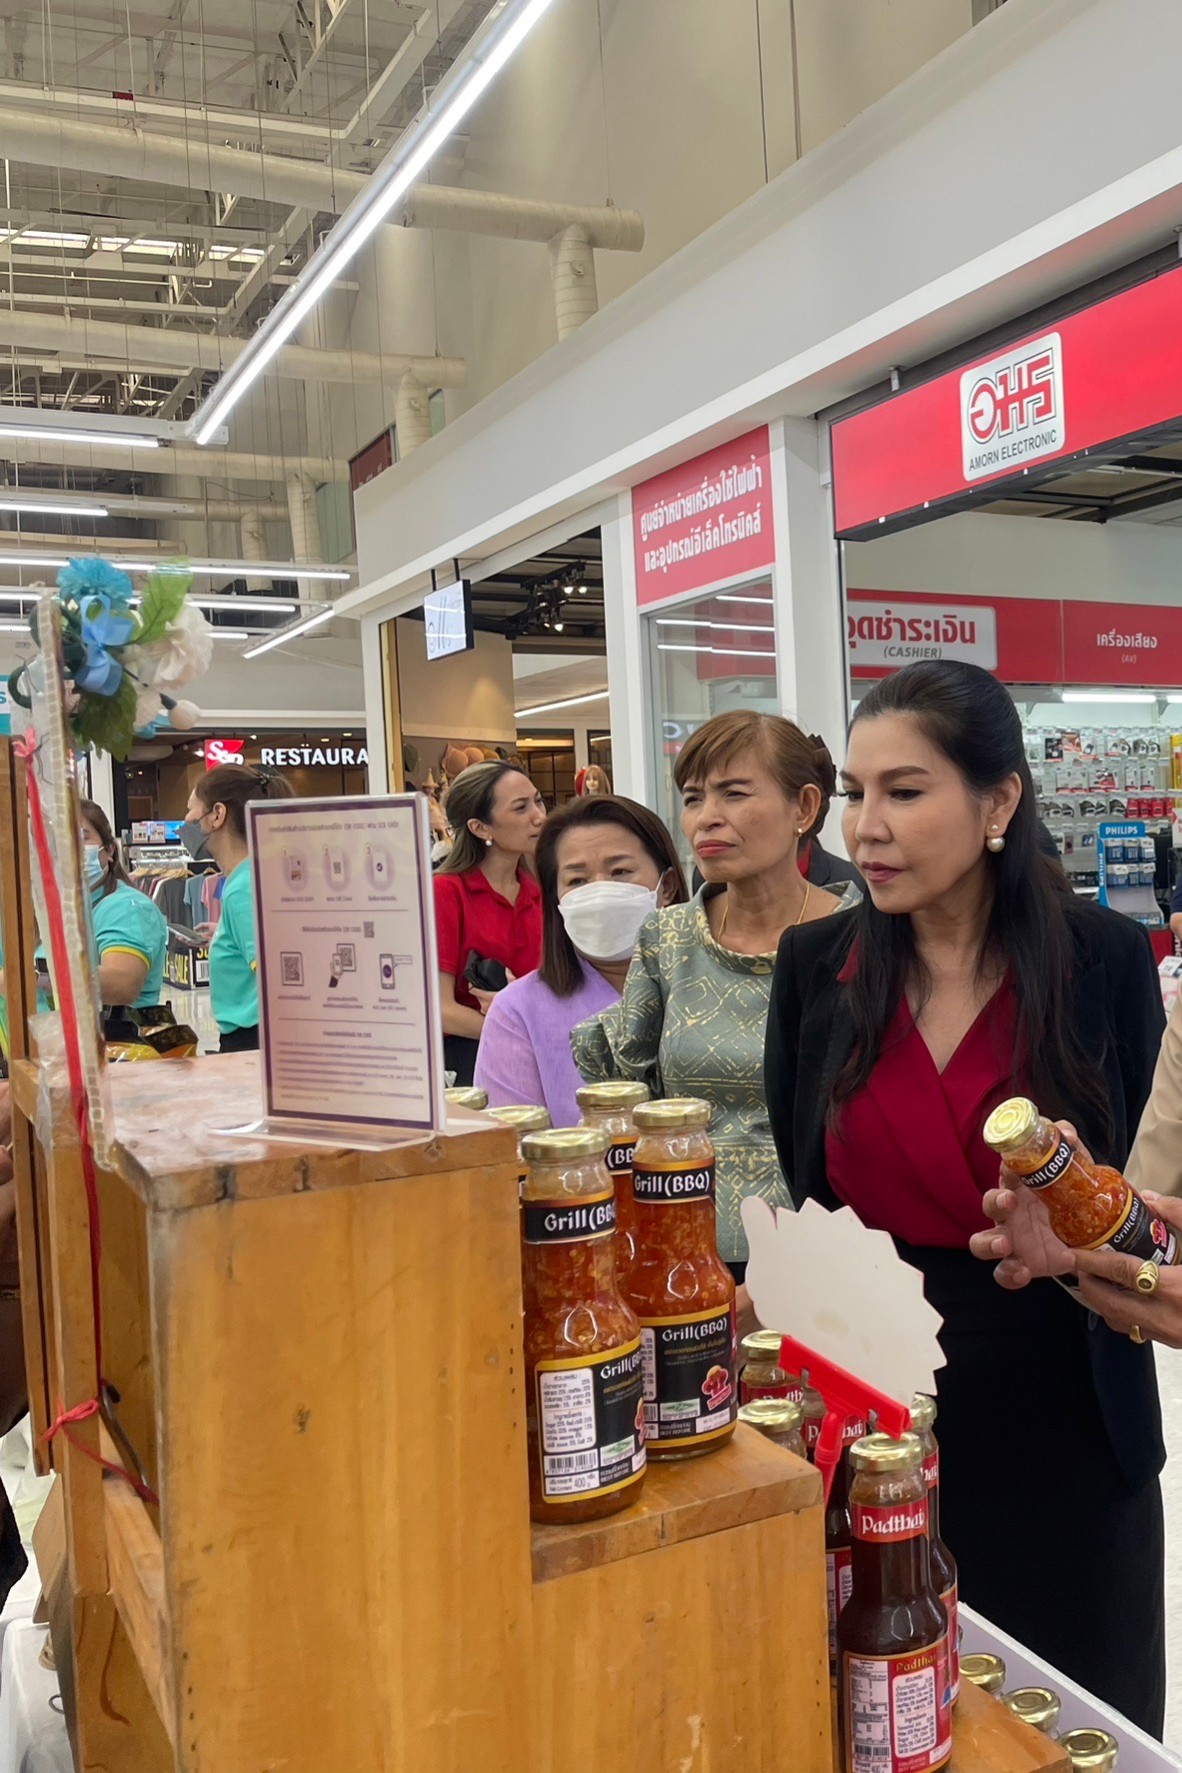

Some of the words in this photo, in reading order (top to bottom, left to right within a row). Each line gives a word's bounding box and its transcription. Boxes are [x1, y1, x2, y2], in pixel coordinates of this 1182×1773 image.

[969, 448, 1000, 472] AMORN
[1001, 429, 1057, 461] ELECTRONIC
[640, 454, 763, 542] ศูนย์จำหน่ายเครื่องใช้ไฟฟ้า
[1096, 628, 1158, 648] เครื่องเสียง
[883, 646, 943, 660] (CASHIER)
[1105, 825, 1139, 836] PHILIPS
[861, 1507, 925, 1535] Padthai
